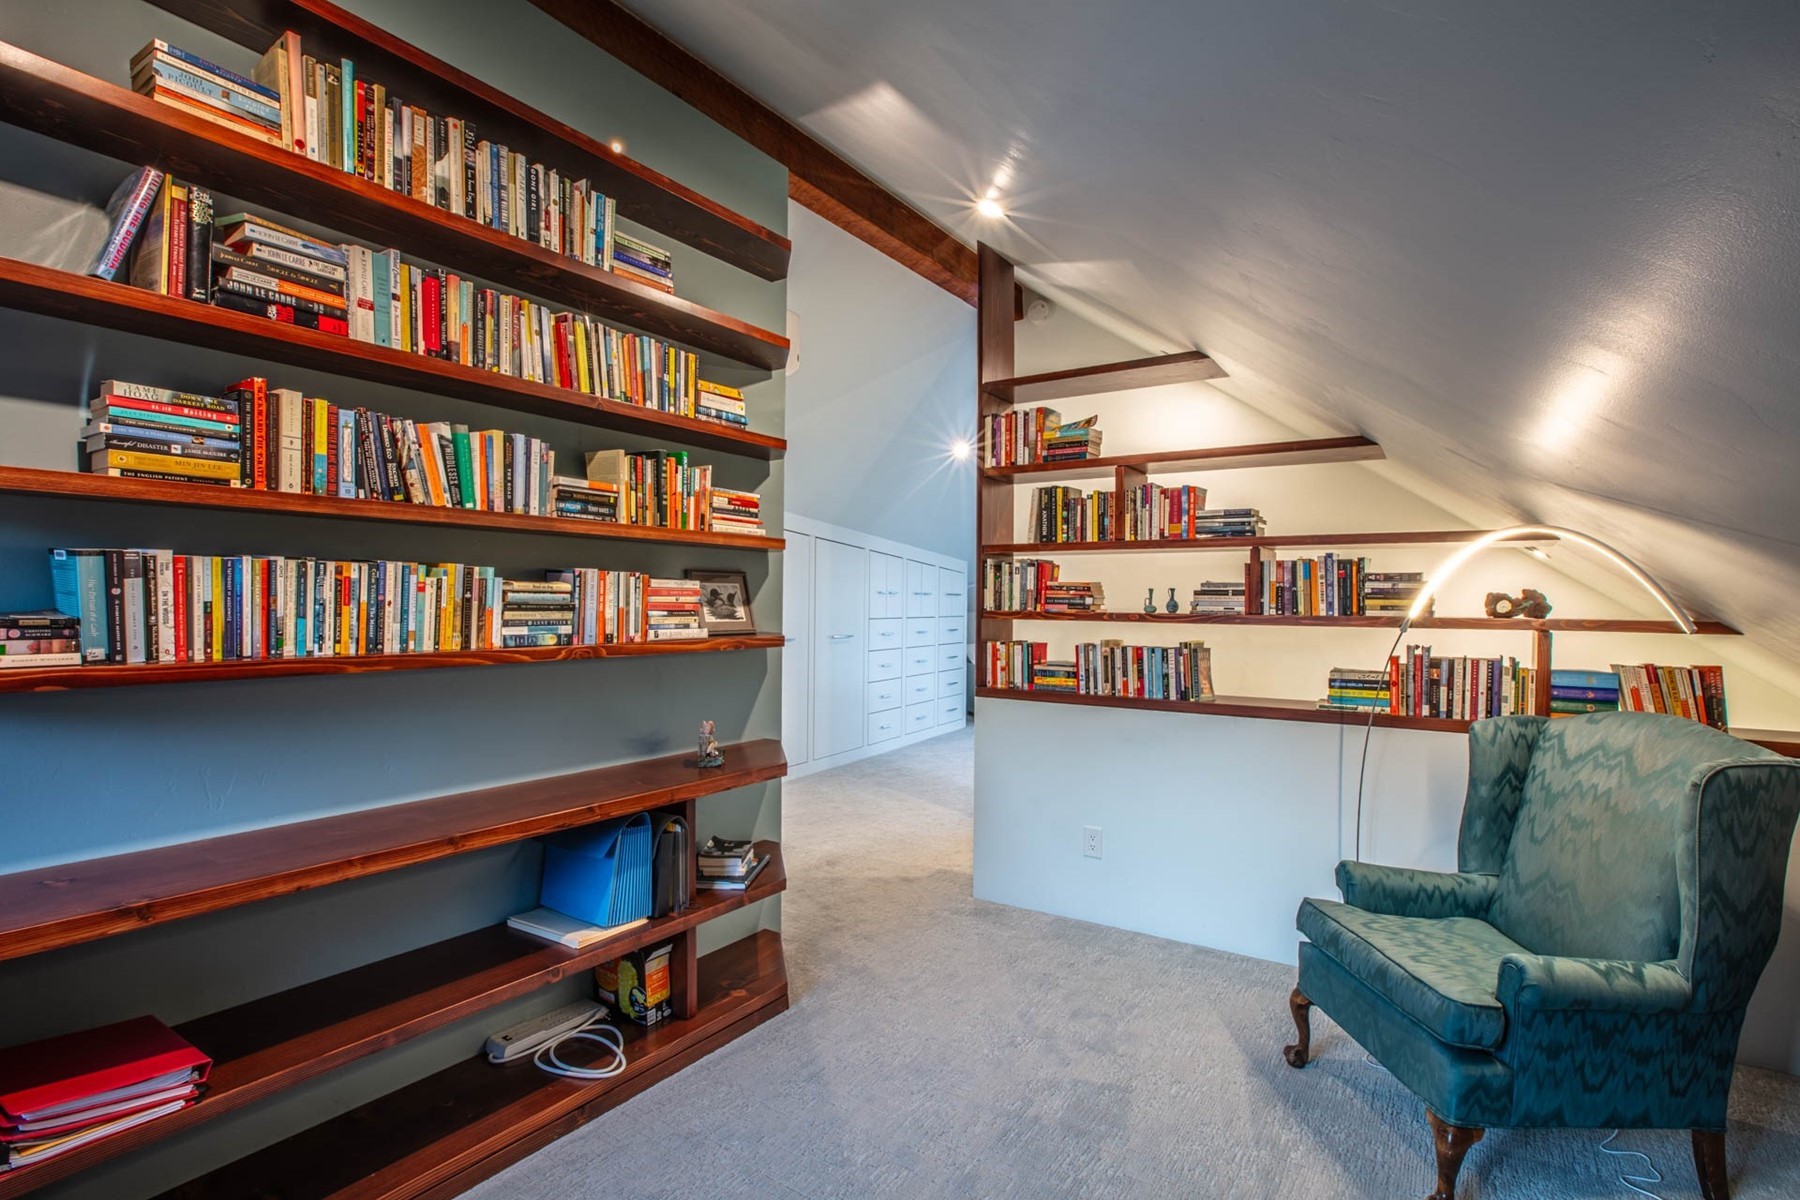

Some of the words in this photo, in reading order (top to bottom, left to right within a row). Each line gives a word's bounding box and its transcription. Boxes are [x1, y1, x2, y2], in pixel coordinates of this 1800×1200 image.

[167, 73, 213, 95] PICOULT
[179, 72, 203, 86] JODI
[138, 172, 163, 209] KILLING
[108, 229, 138, 270] BUDDHA
[227, 280, 252, 295] JOHN
[255, 288, 266, 298] LE
[123, 389, 159, 401] HOAG
[180, 393, 202, 402] DOWN
[173, 398, 205, 409] DARKEST
[206, 403, 226, 412] ROAD
[183, 408, 217, 420] Waiting
[137, 442, 169, 452] DISASTER
[203, 450, 227, 458] McGUIRE
[175, 460, 192, 468] MIN
[193, 461, 207, 470] JIN
[208, 463, 223, 471] LEE
[444, 447, 458, 485] MIDDLESEX
